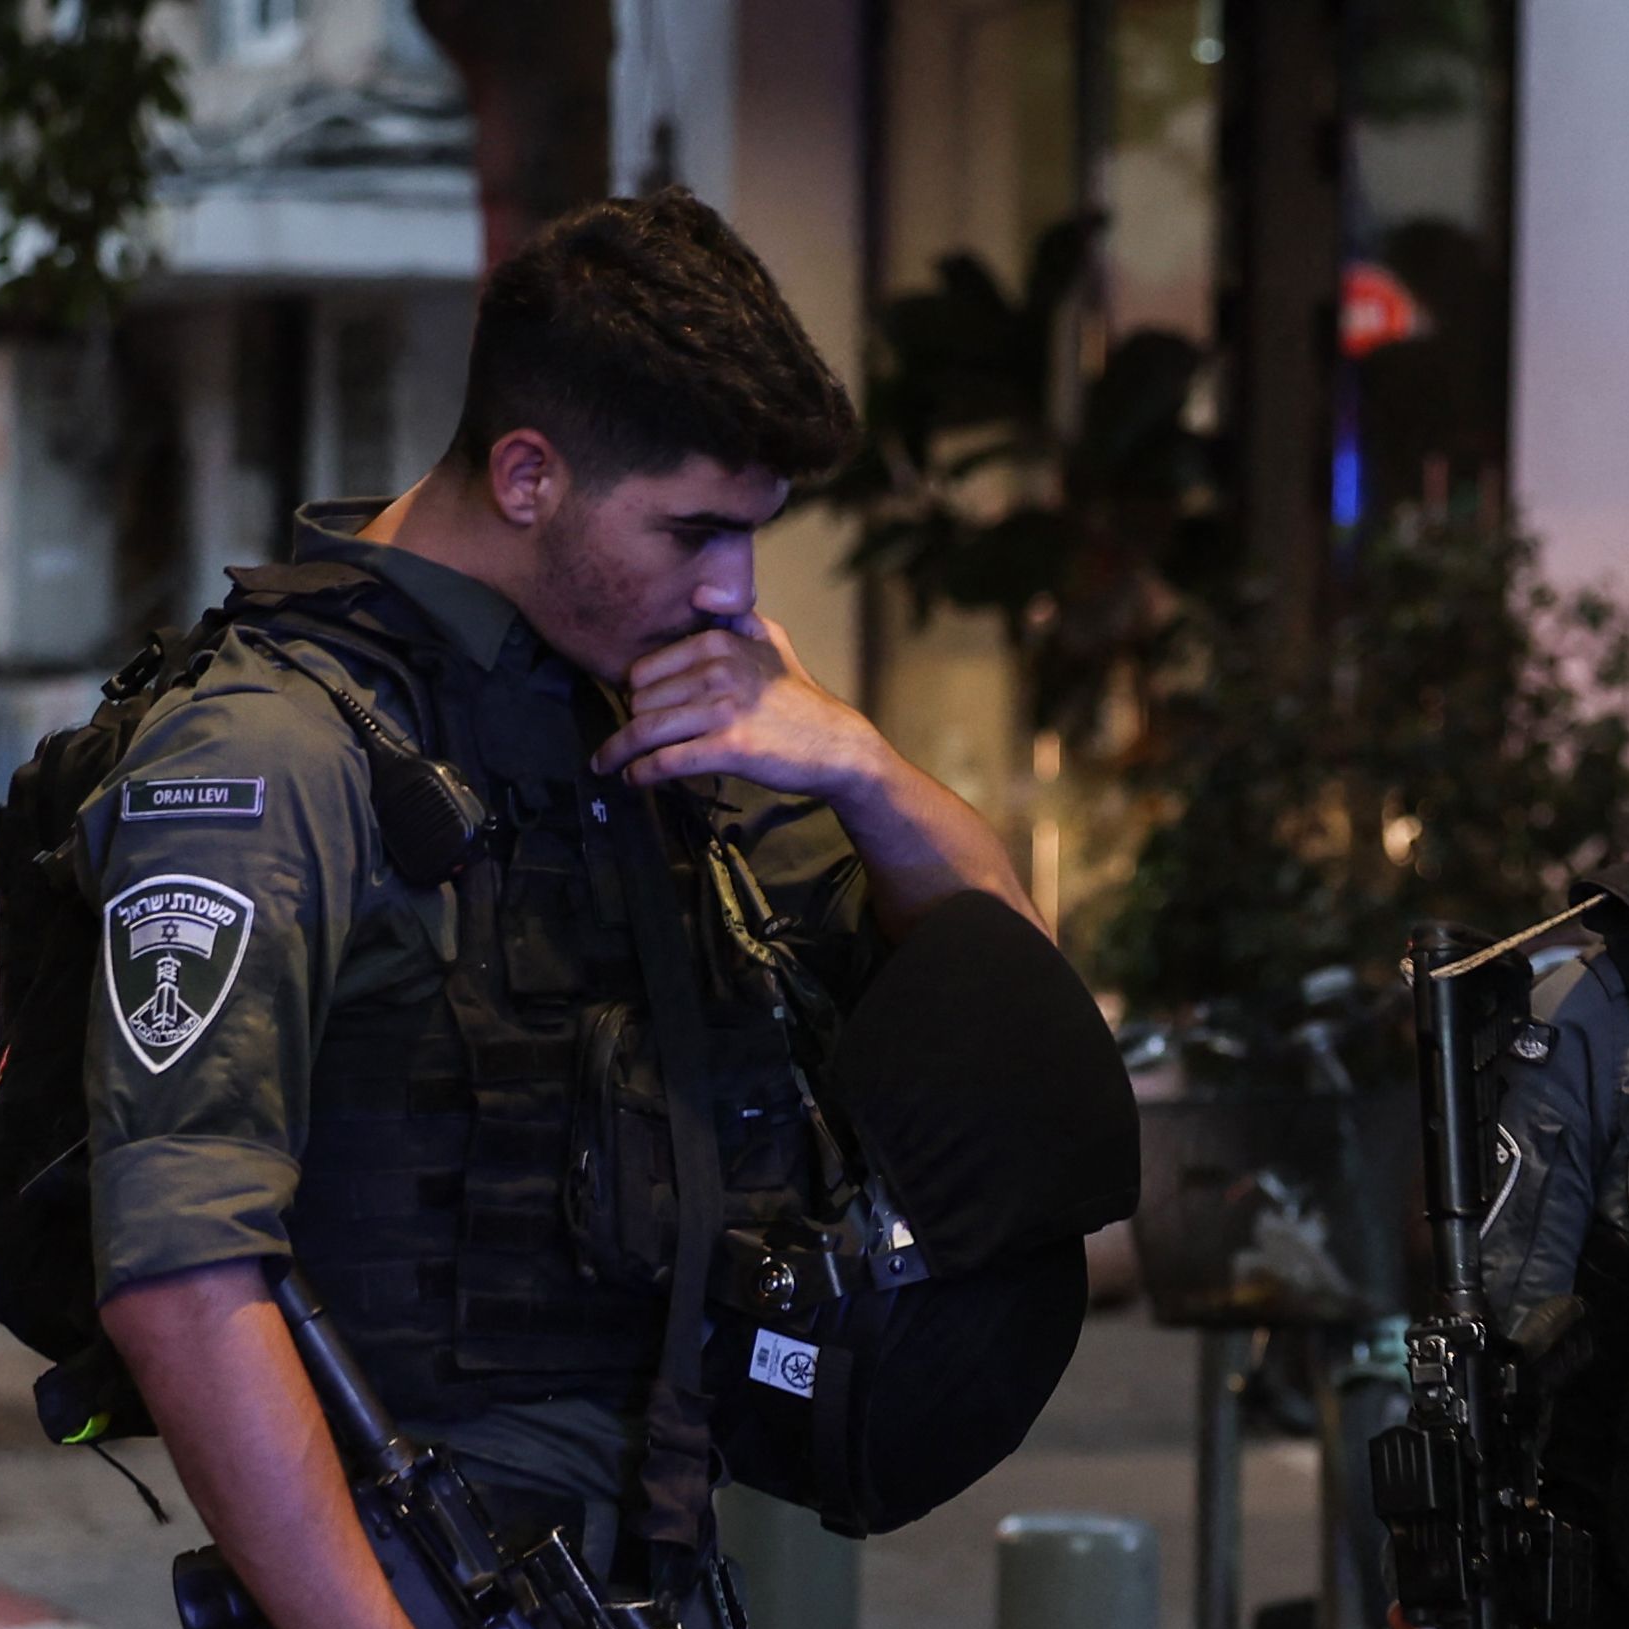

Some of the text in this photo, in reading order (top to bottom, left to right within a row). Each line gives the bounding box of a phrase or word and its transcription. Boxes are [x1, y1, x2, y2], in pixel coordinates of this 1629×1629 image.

[153, 787, 229, 805] ORAN LEVI
[118, 893, 237, 927] משטרת ישראל
